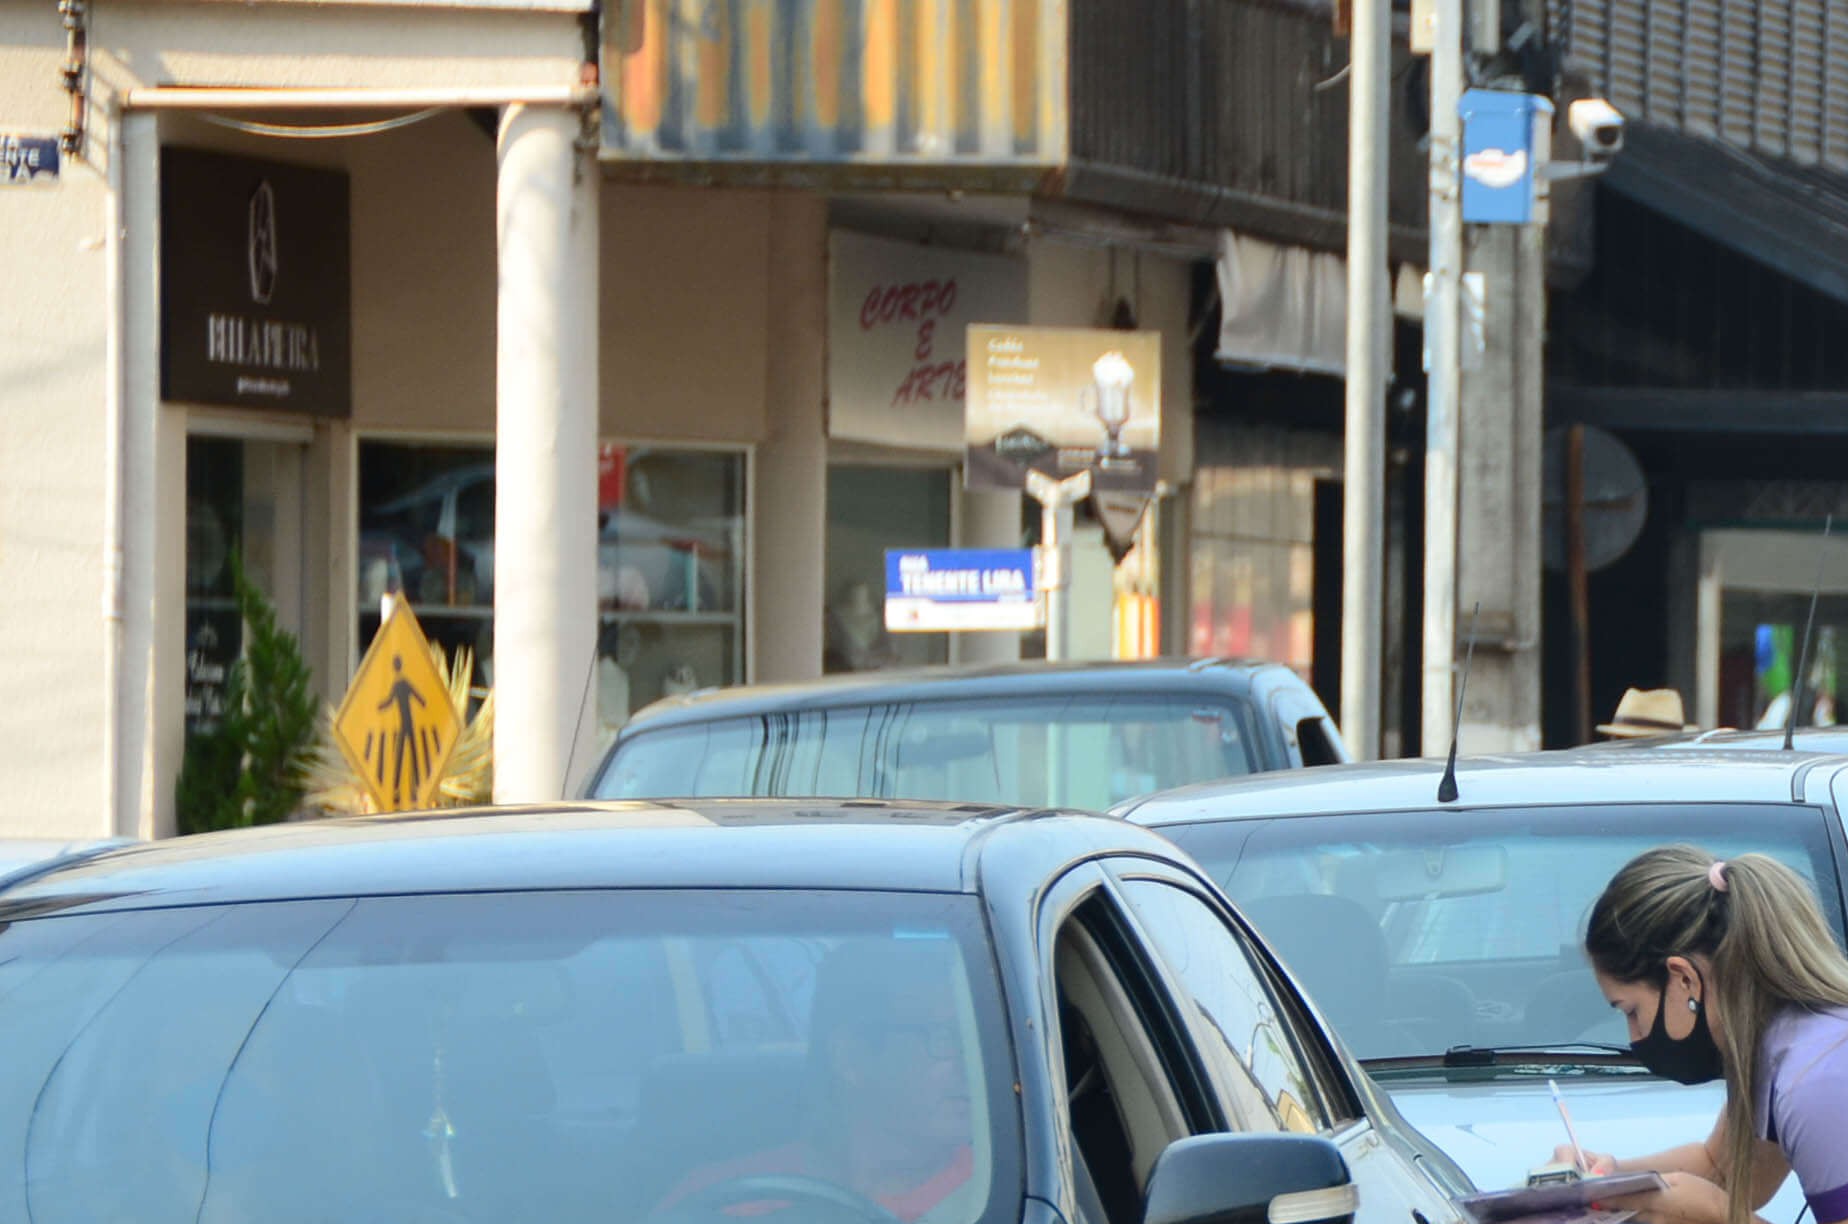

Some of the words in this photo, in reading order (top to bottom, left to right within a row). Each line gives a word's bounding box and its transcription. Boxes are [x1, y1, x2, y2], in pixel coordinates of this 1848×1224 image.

[860, 278, 957, 330] CORPO
[903, 570, 980, 595] TENENTE
[982, 569, 1025, 593] LIRA
